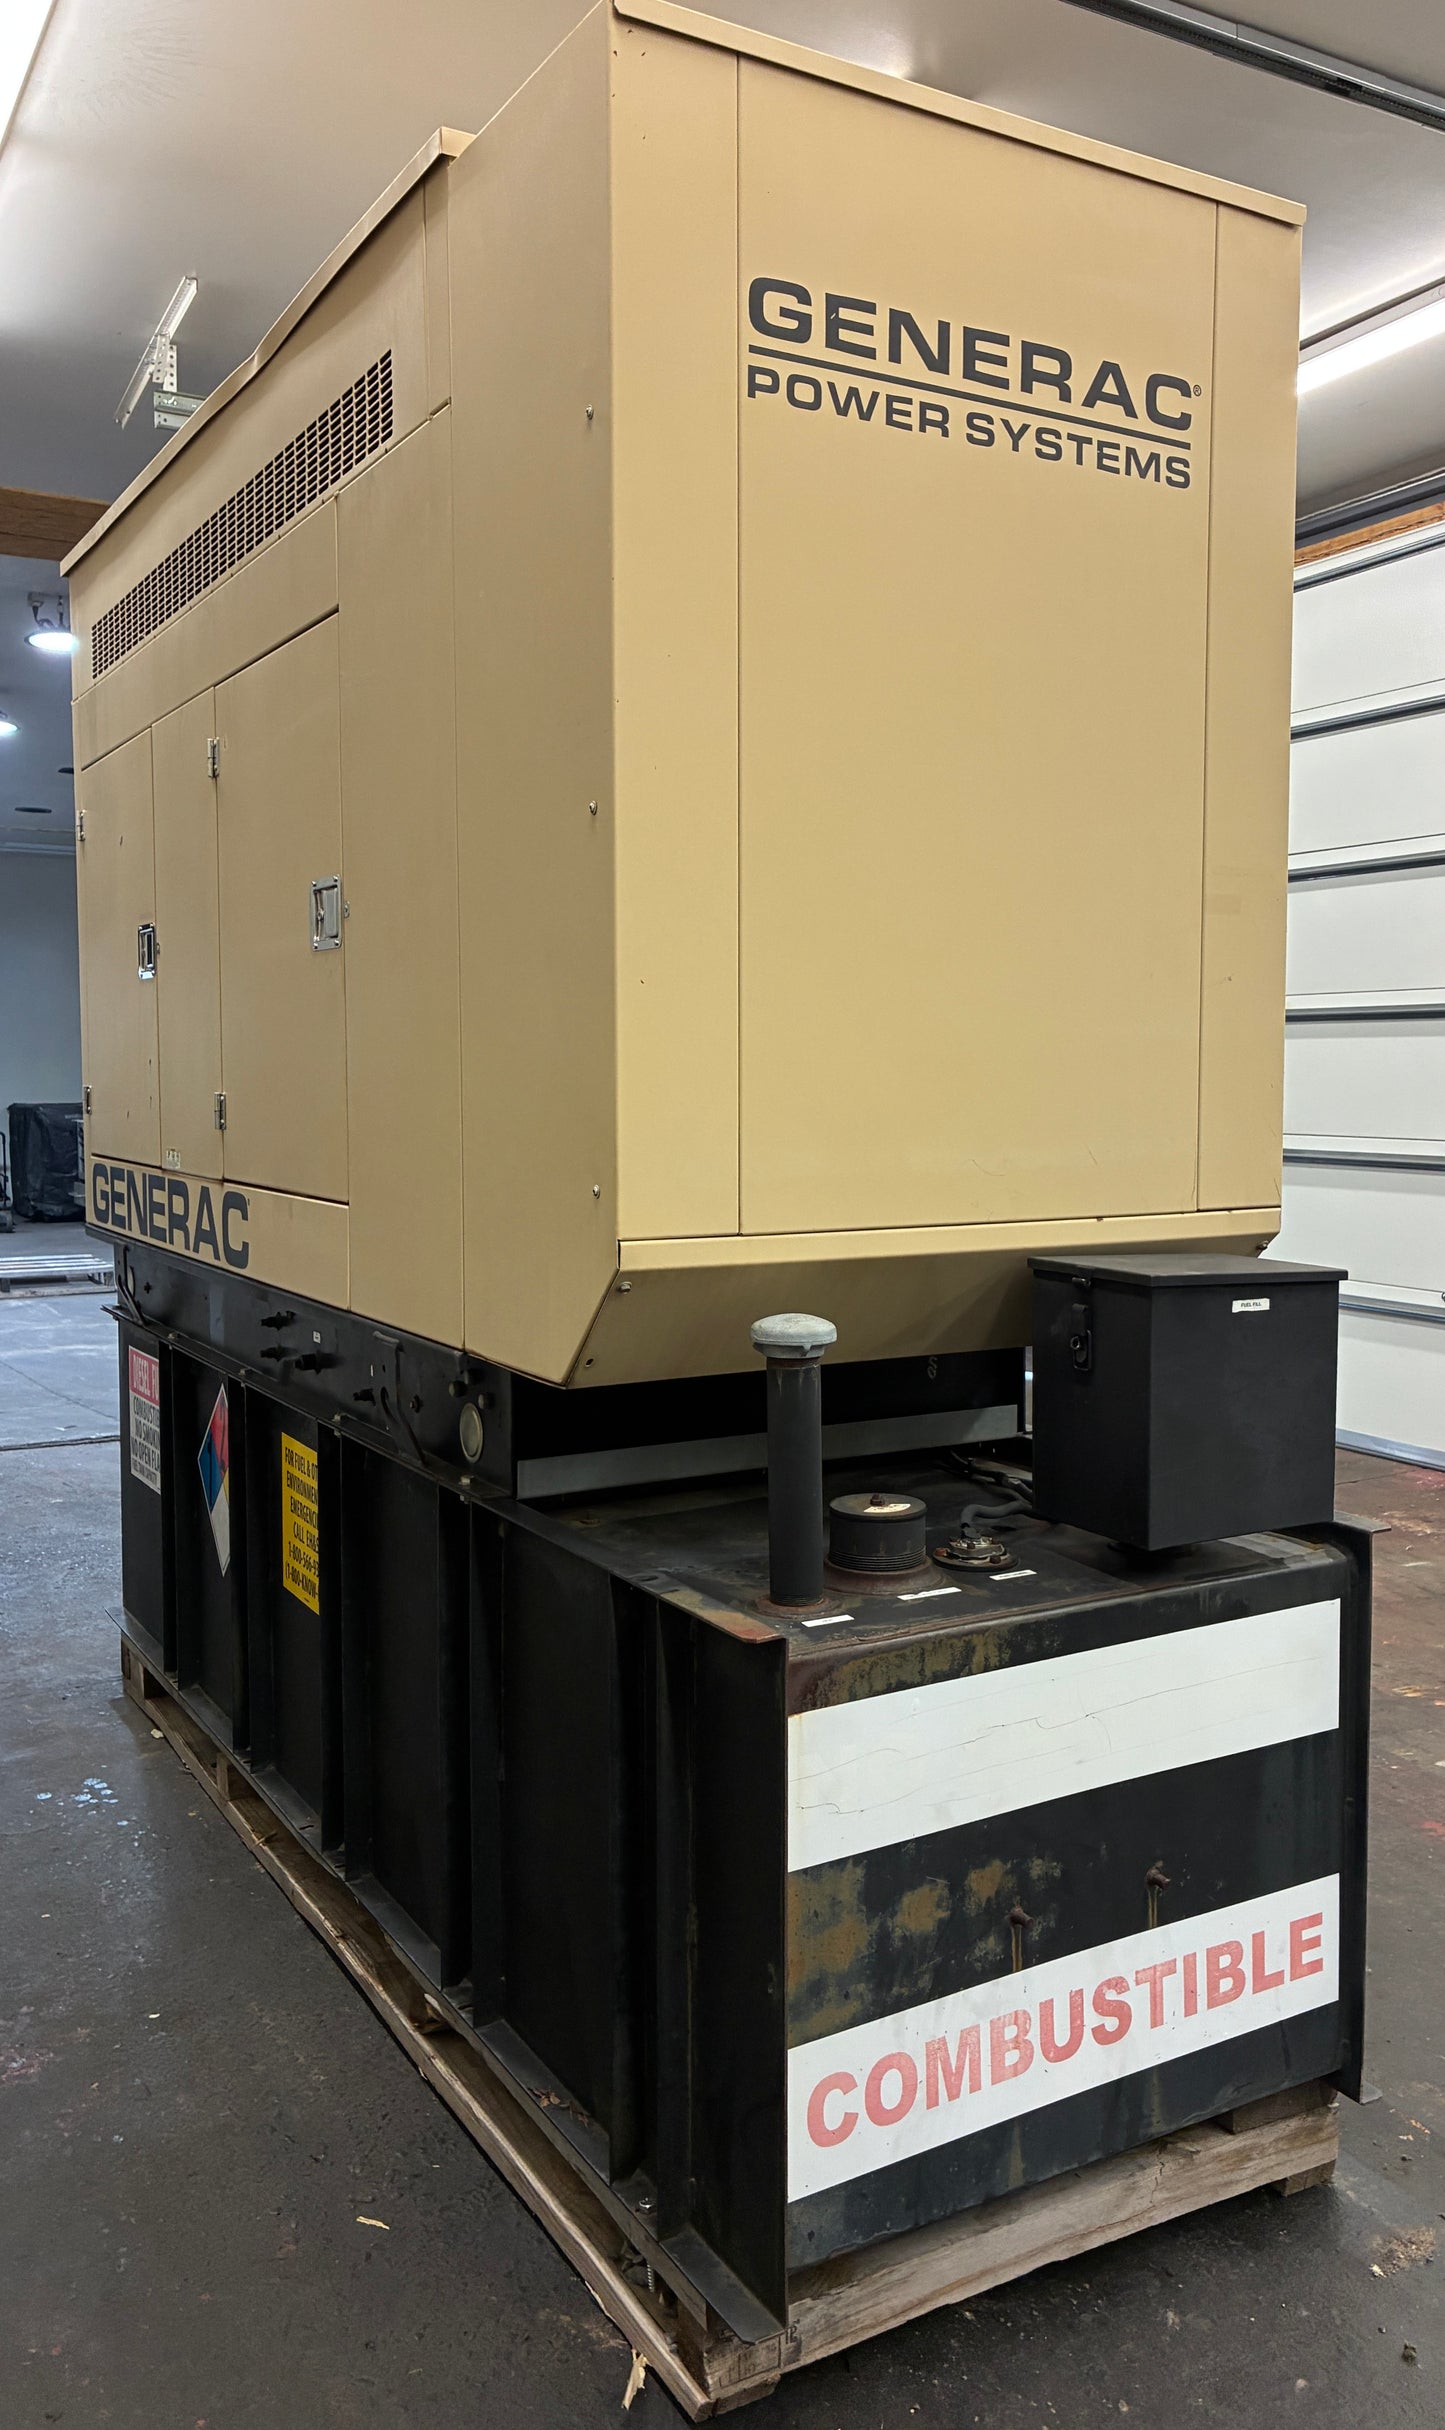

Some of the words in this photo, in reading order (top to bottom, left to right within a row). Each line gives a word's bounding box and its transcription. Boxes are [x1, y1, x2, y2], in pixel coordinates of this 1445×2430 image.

[748, 277, 1192, 431] GENERAC
[747, 364, 949, 438] POWER
[965, 412, 1191, 489] SYSTEMS
[92, 1163, 249, 1269] GENERAC
[133, 1354, 151, 1396] DIESEL
[135, 1418, 142, 1439] NO
[131, 1436, 138, 1457] NO
[139, 1441, 151, 1468] OPEN
[151, 1449, 161, 1472] FLA
[285, 1446, 294, 1467] FOR
[295, 1452, 306, 1475] FUEL
[306, 1459, 311, 1478] &
[286, 1470, 319, 1506] ENVIRONMEN
[290, 1496, 318, 1529] EMERGENCI
[293, 1521, 305, 1544] CALL
[288, 1540, 319, 1577] 1-800-566-93
[285, 1559, 319, 1599] (1-800-KNOW-
[806, 1912, 1324, 2149] COMBUSTIBLE
